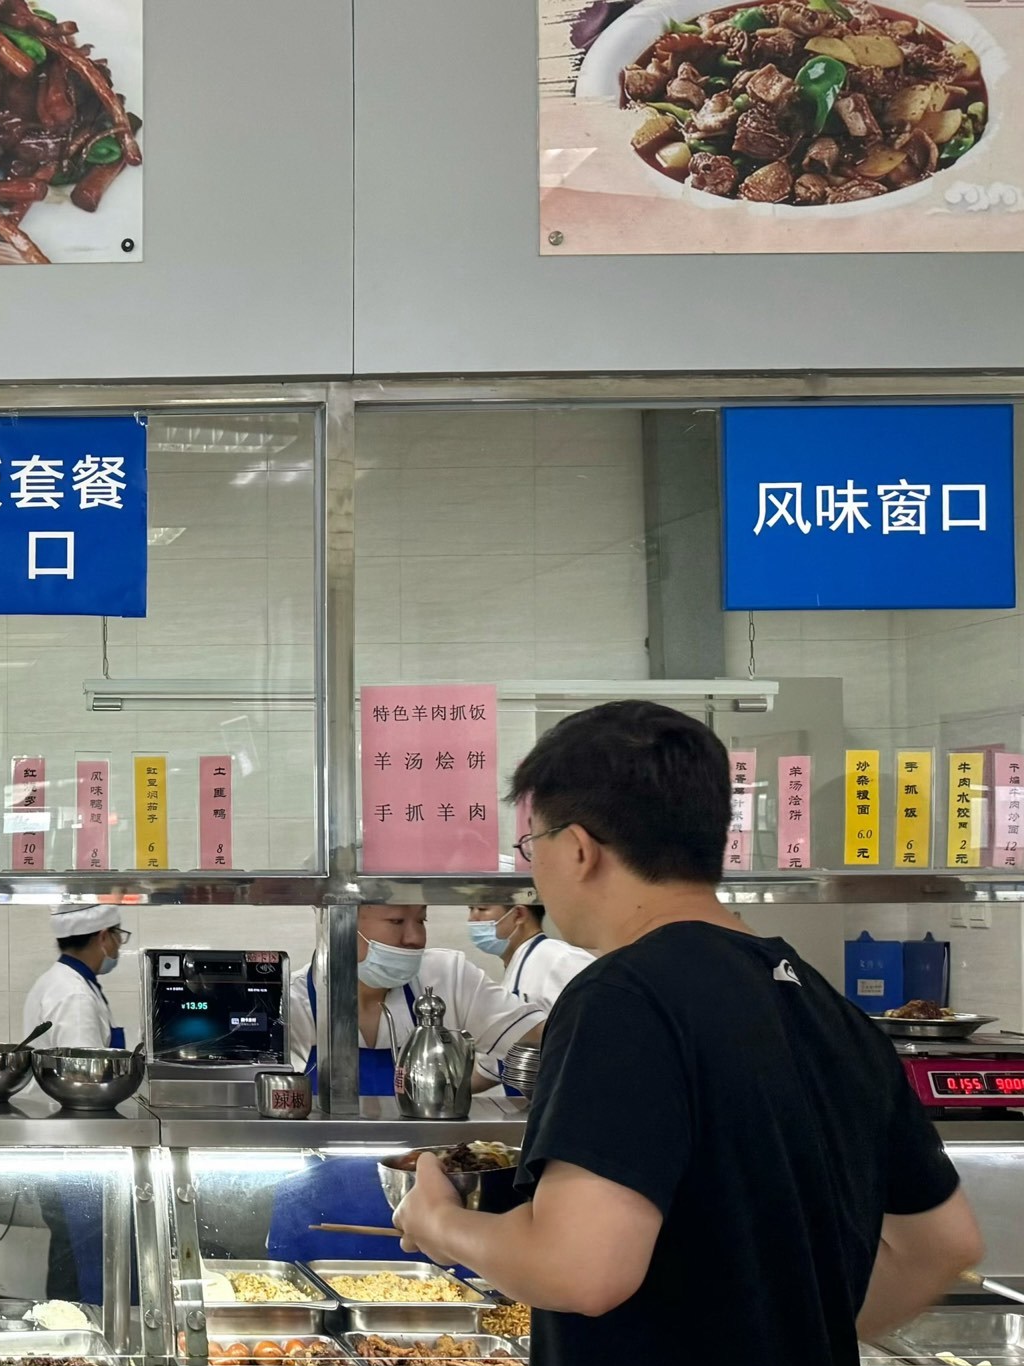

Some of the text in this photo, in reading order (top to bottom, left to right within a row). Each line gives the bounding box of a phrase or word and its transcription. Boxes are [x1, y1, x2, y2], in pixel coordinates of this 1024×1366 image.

[753, 478, 987, 536] 风味窗口
[373, 703, 488, 723] 特色羊肉抓饭
[373, 750, 487, 771] 羊汤烩饼
[903, 761, 919, 819] 手抓饭
[373, 802, 487, 823] 手抓羊肉
